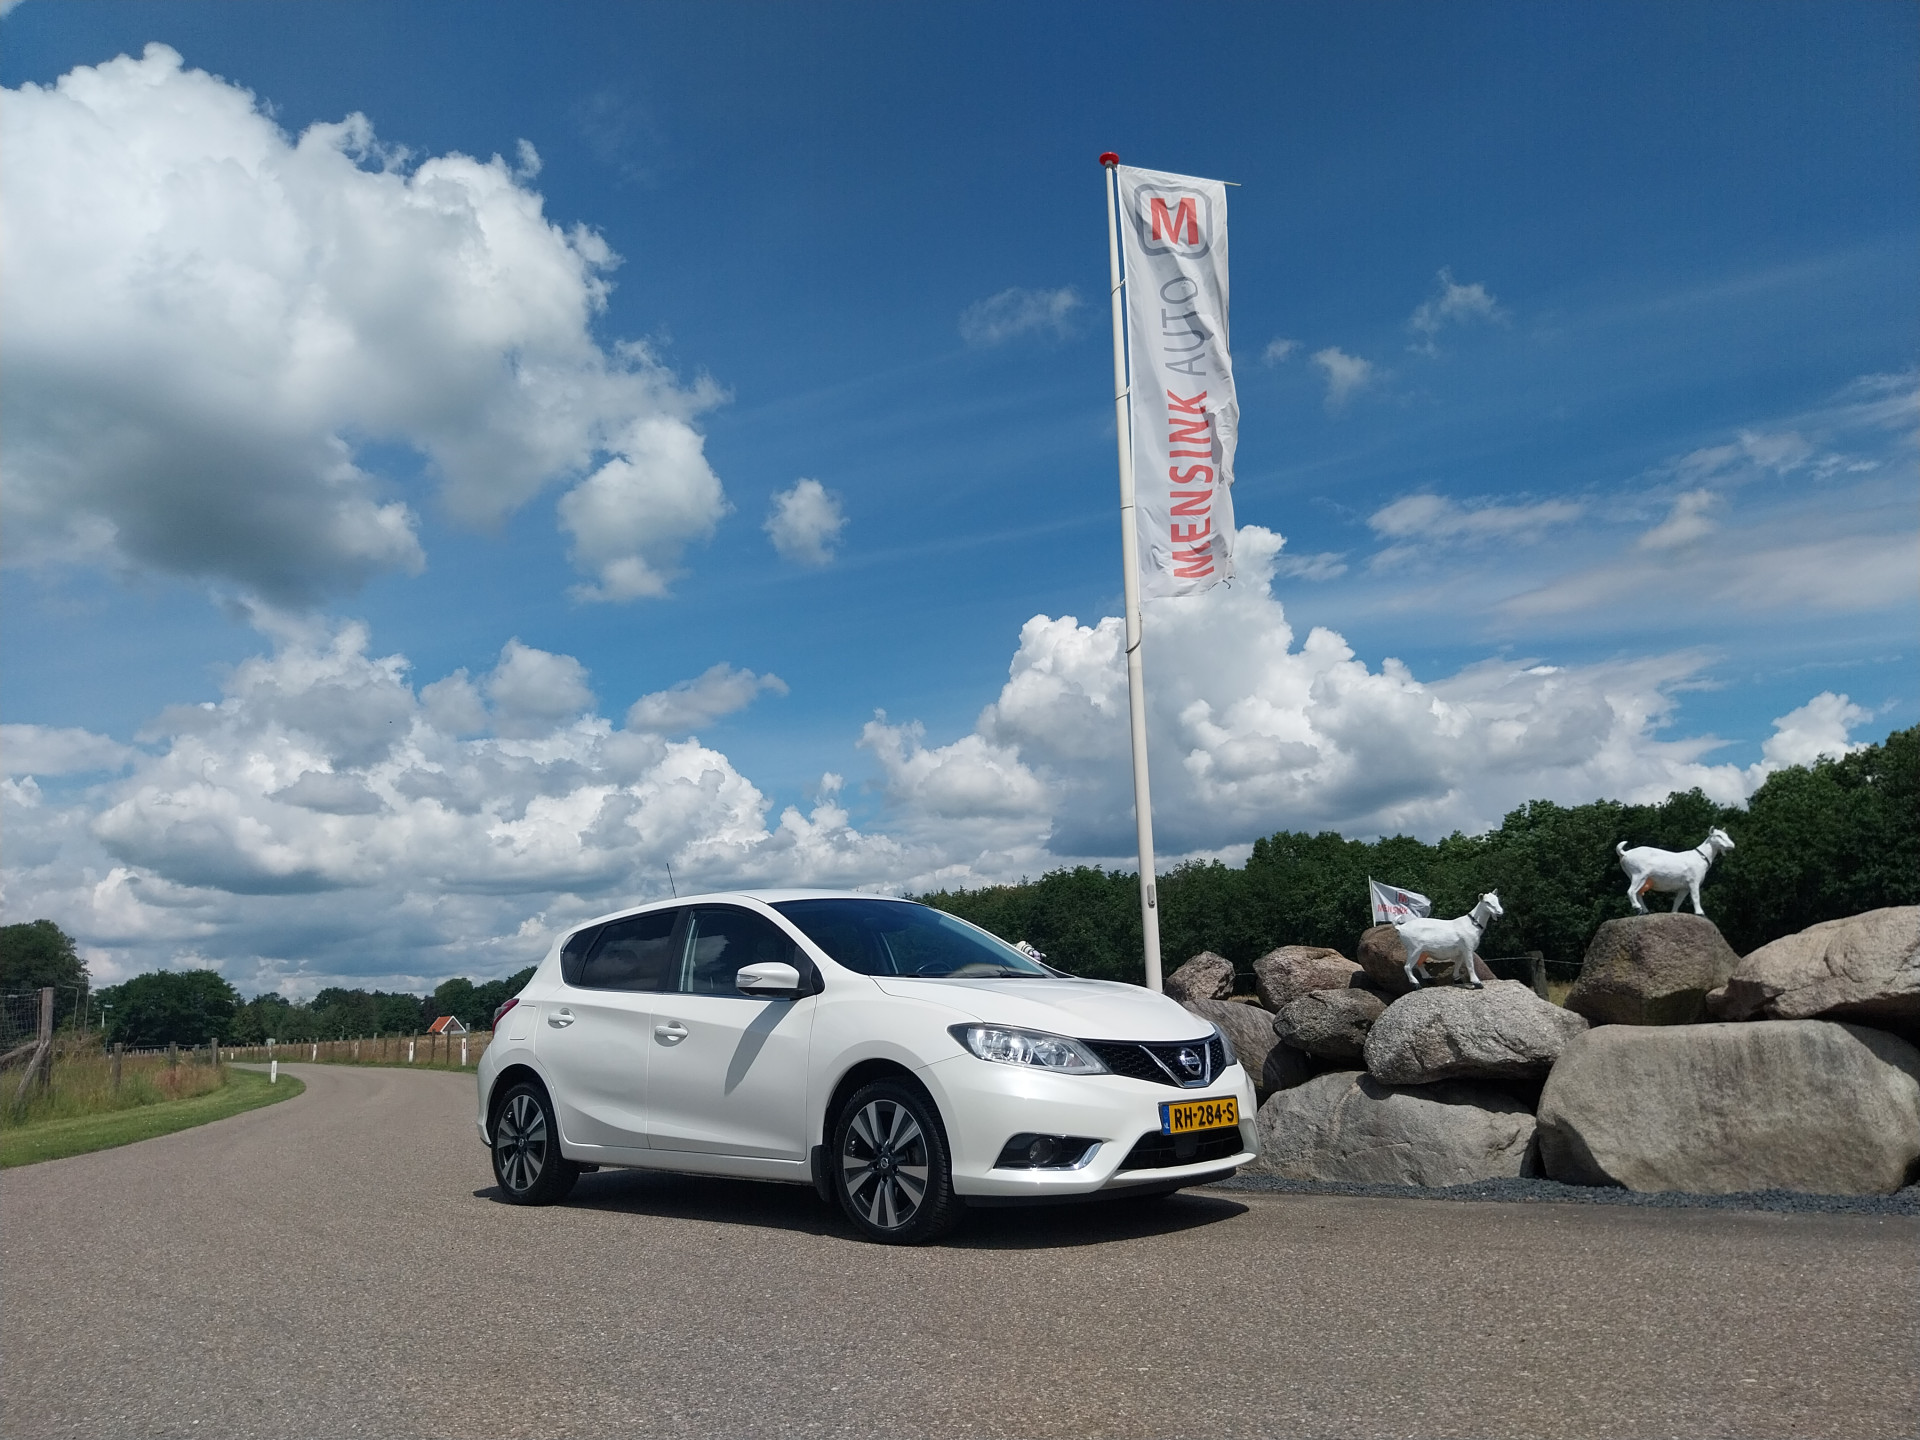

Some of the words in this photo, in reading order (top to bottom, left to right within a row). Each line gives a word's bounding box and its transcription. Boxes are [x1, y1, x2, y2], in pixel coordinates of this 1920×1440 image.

[1150, 197, 1199, 245] M
[1160, 276, 1207, 376] AUTO
[1166, 388, 1215, 579] MENSINK
[1174, 1102, 1235, 1129] RH-284-S
